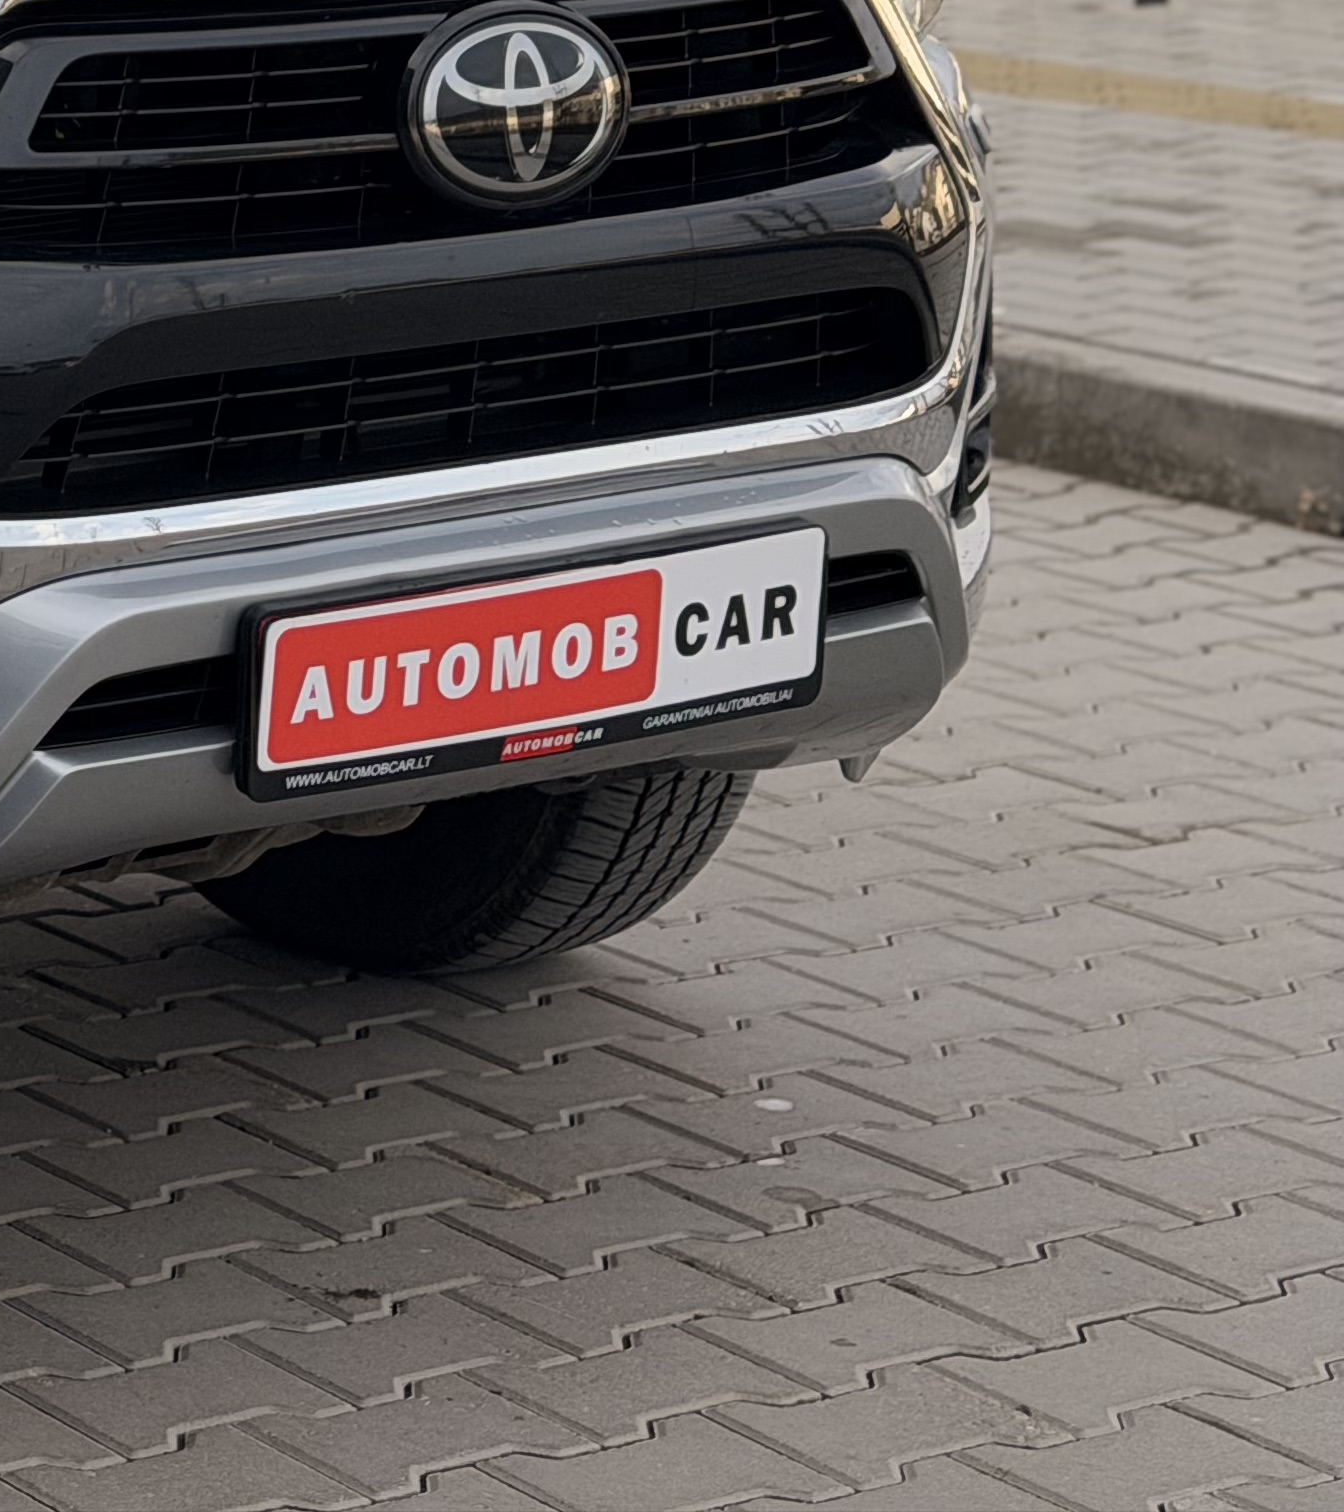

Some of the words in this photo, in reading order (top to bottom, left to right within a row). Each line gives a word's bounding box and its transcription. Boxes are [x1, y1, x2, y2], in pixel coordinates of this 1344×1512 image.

[289, 613, 639, 725] AUTOMOB
[674, 584, 798, 657] CAR
[285, 755, 434, 789] WWW.AUTOMOBCAR.LT
